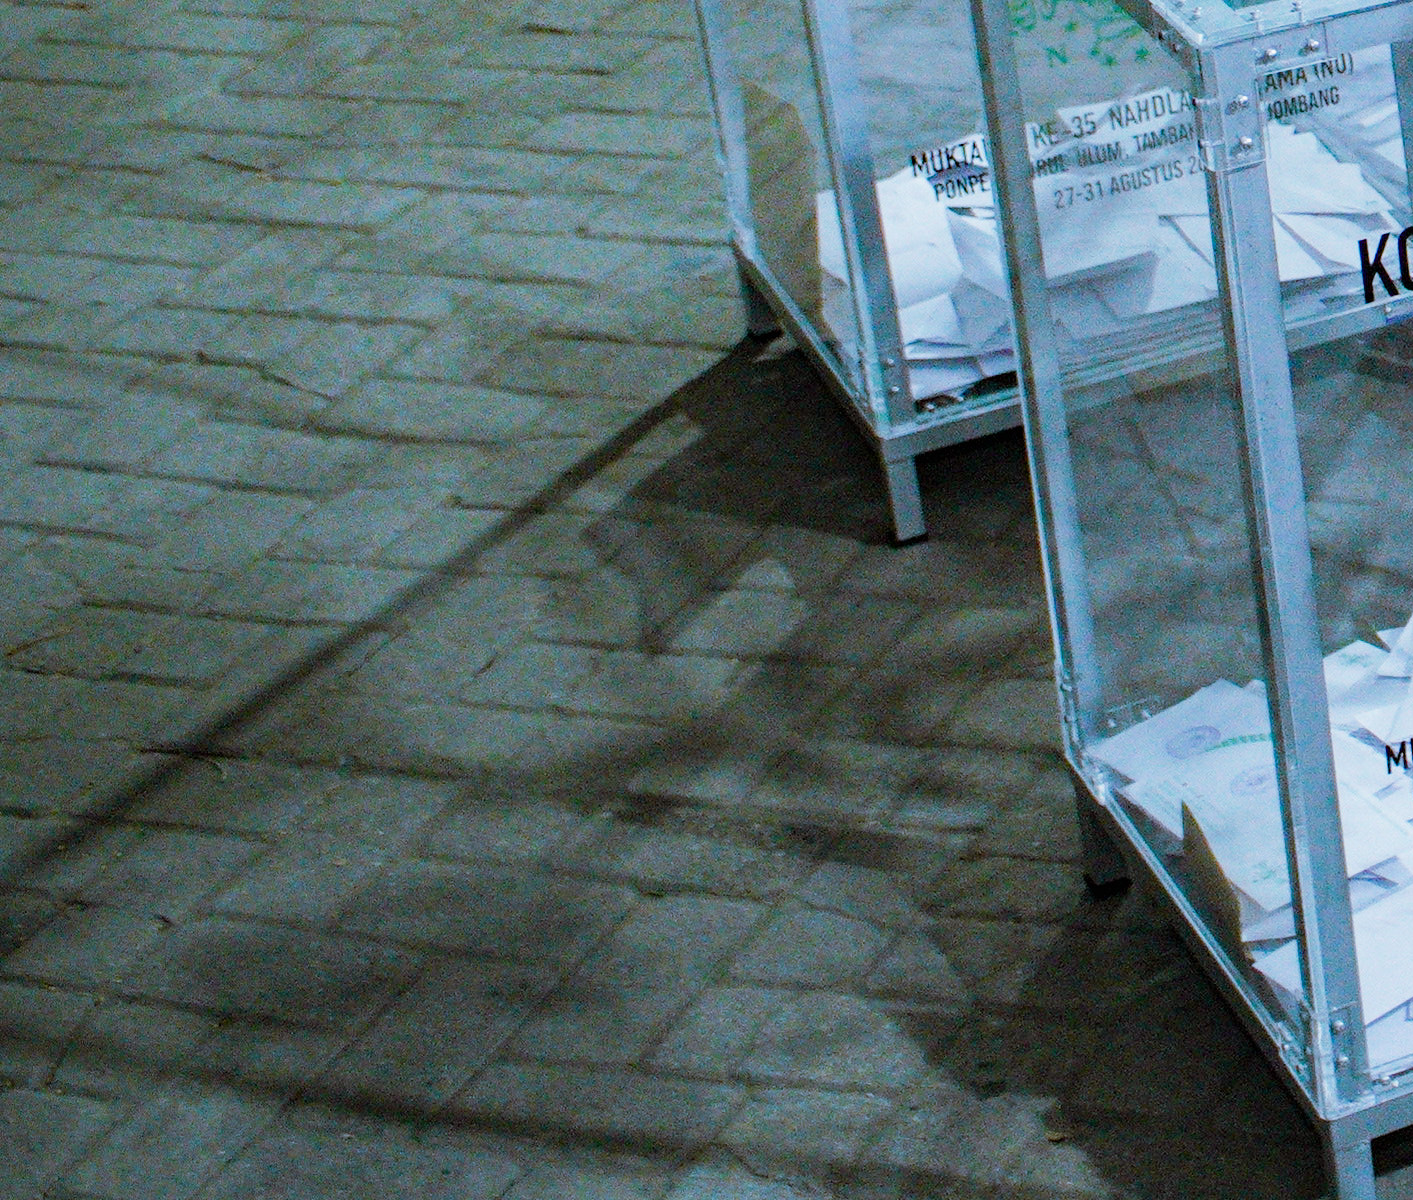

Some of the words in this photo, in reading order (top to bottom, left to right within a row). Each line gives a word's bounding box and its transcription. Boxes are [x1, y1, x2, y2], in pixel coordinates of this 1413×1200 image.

[911, 138, 985, 177] MUKTA
[1032, 113, 1097, 149] KE-35
[1109, 90, 1196, 130] NAHDLA
[934, 171, 990, 201] PONPE
[1054, 181, 1104, 209] 27-31
[1110, 160, 1183, 195] AGUSTUS
